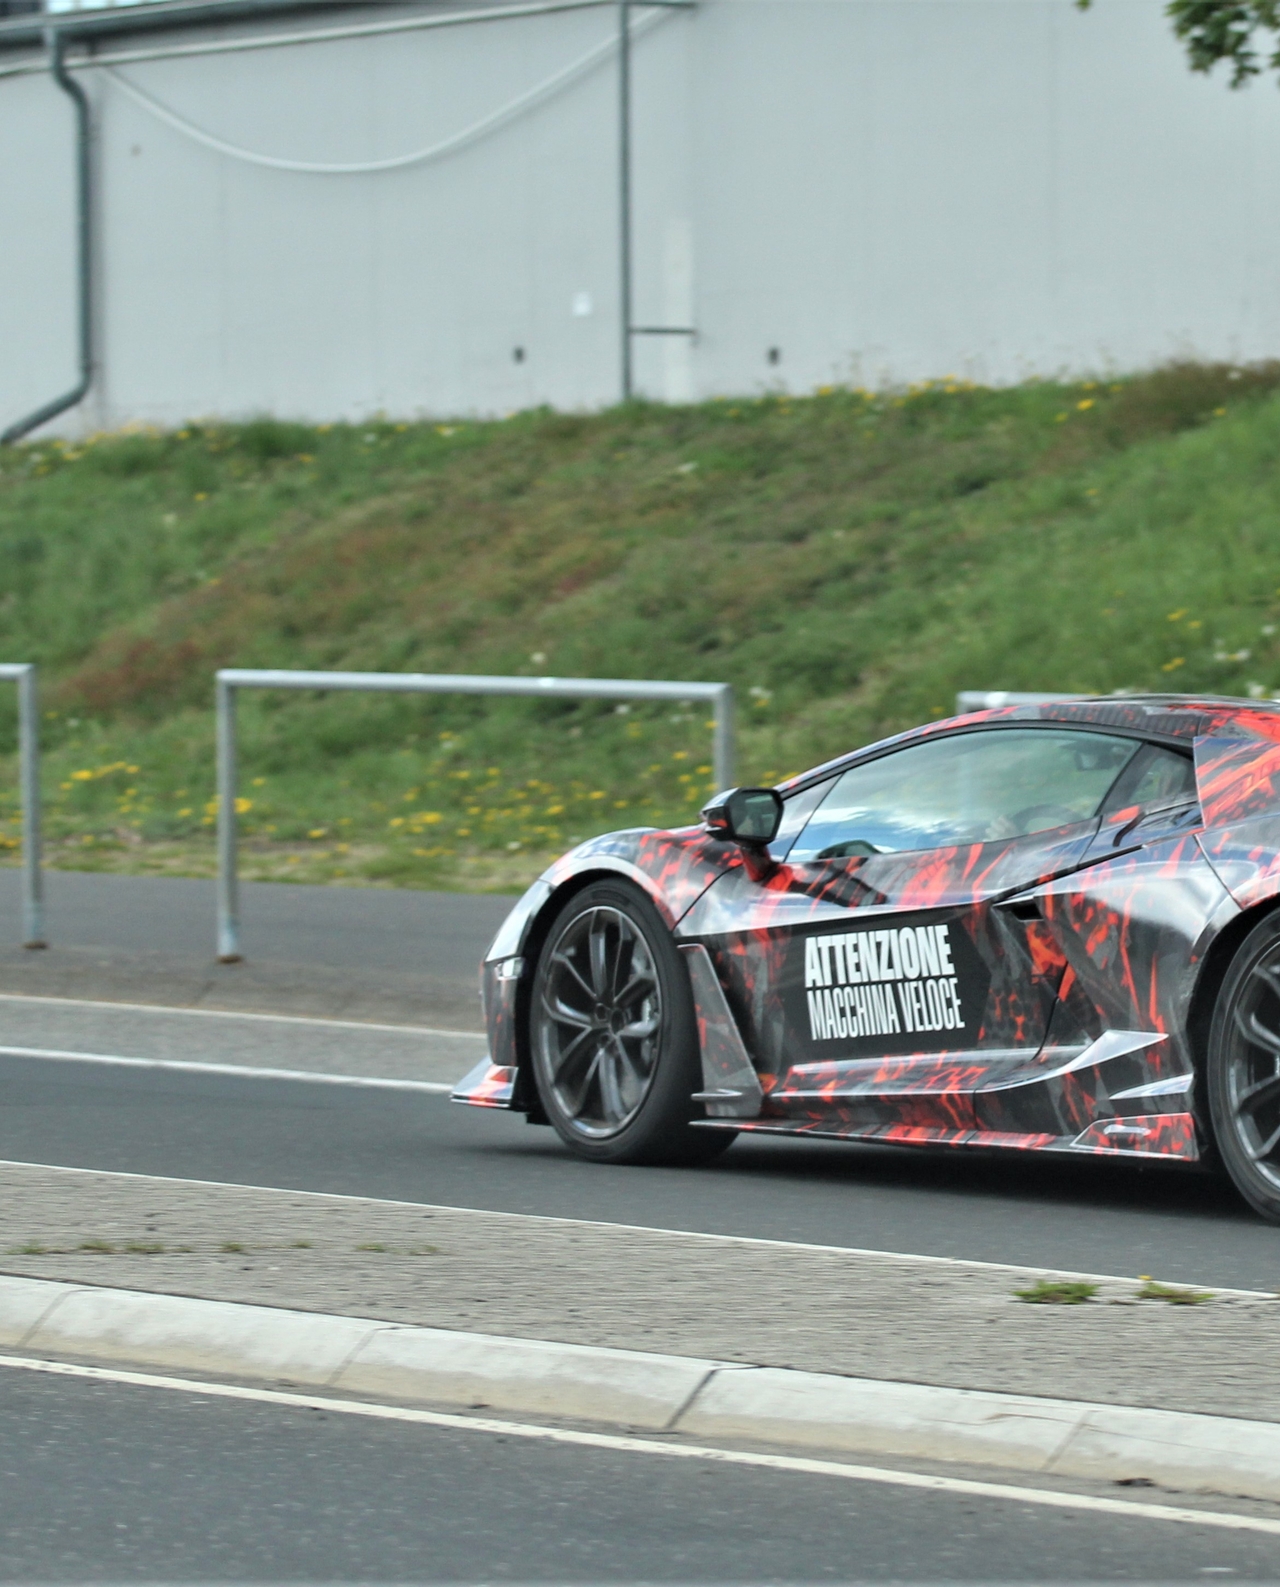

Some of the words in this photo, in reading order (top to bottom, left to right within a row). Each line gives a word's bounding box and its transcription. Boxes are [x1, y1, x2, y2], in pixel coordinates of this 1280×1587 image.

[805, 924, 955, 988] ATTENZIONE
[807, 983, 901, 1041] MACCHINA
[897, 977, 965, 1033] VELOCE
